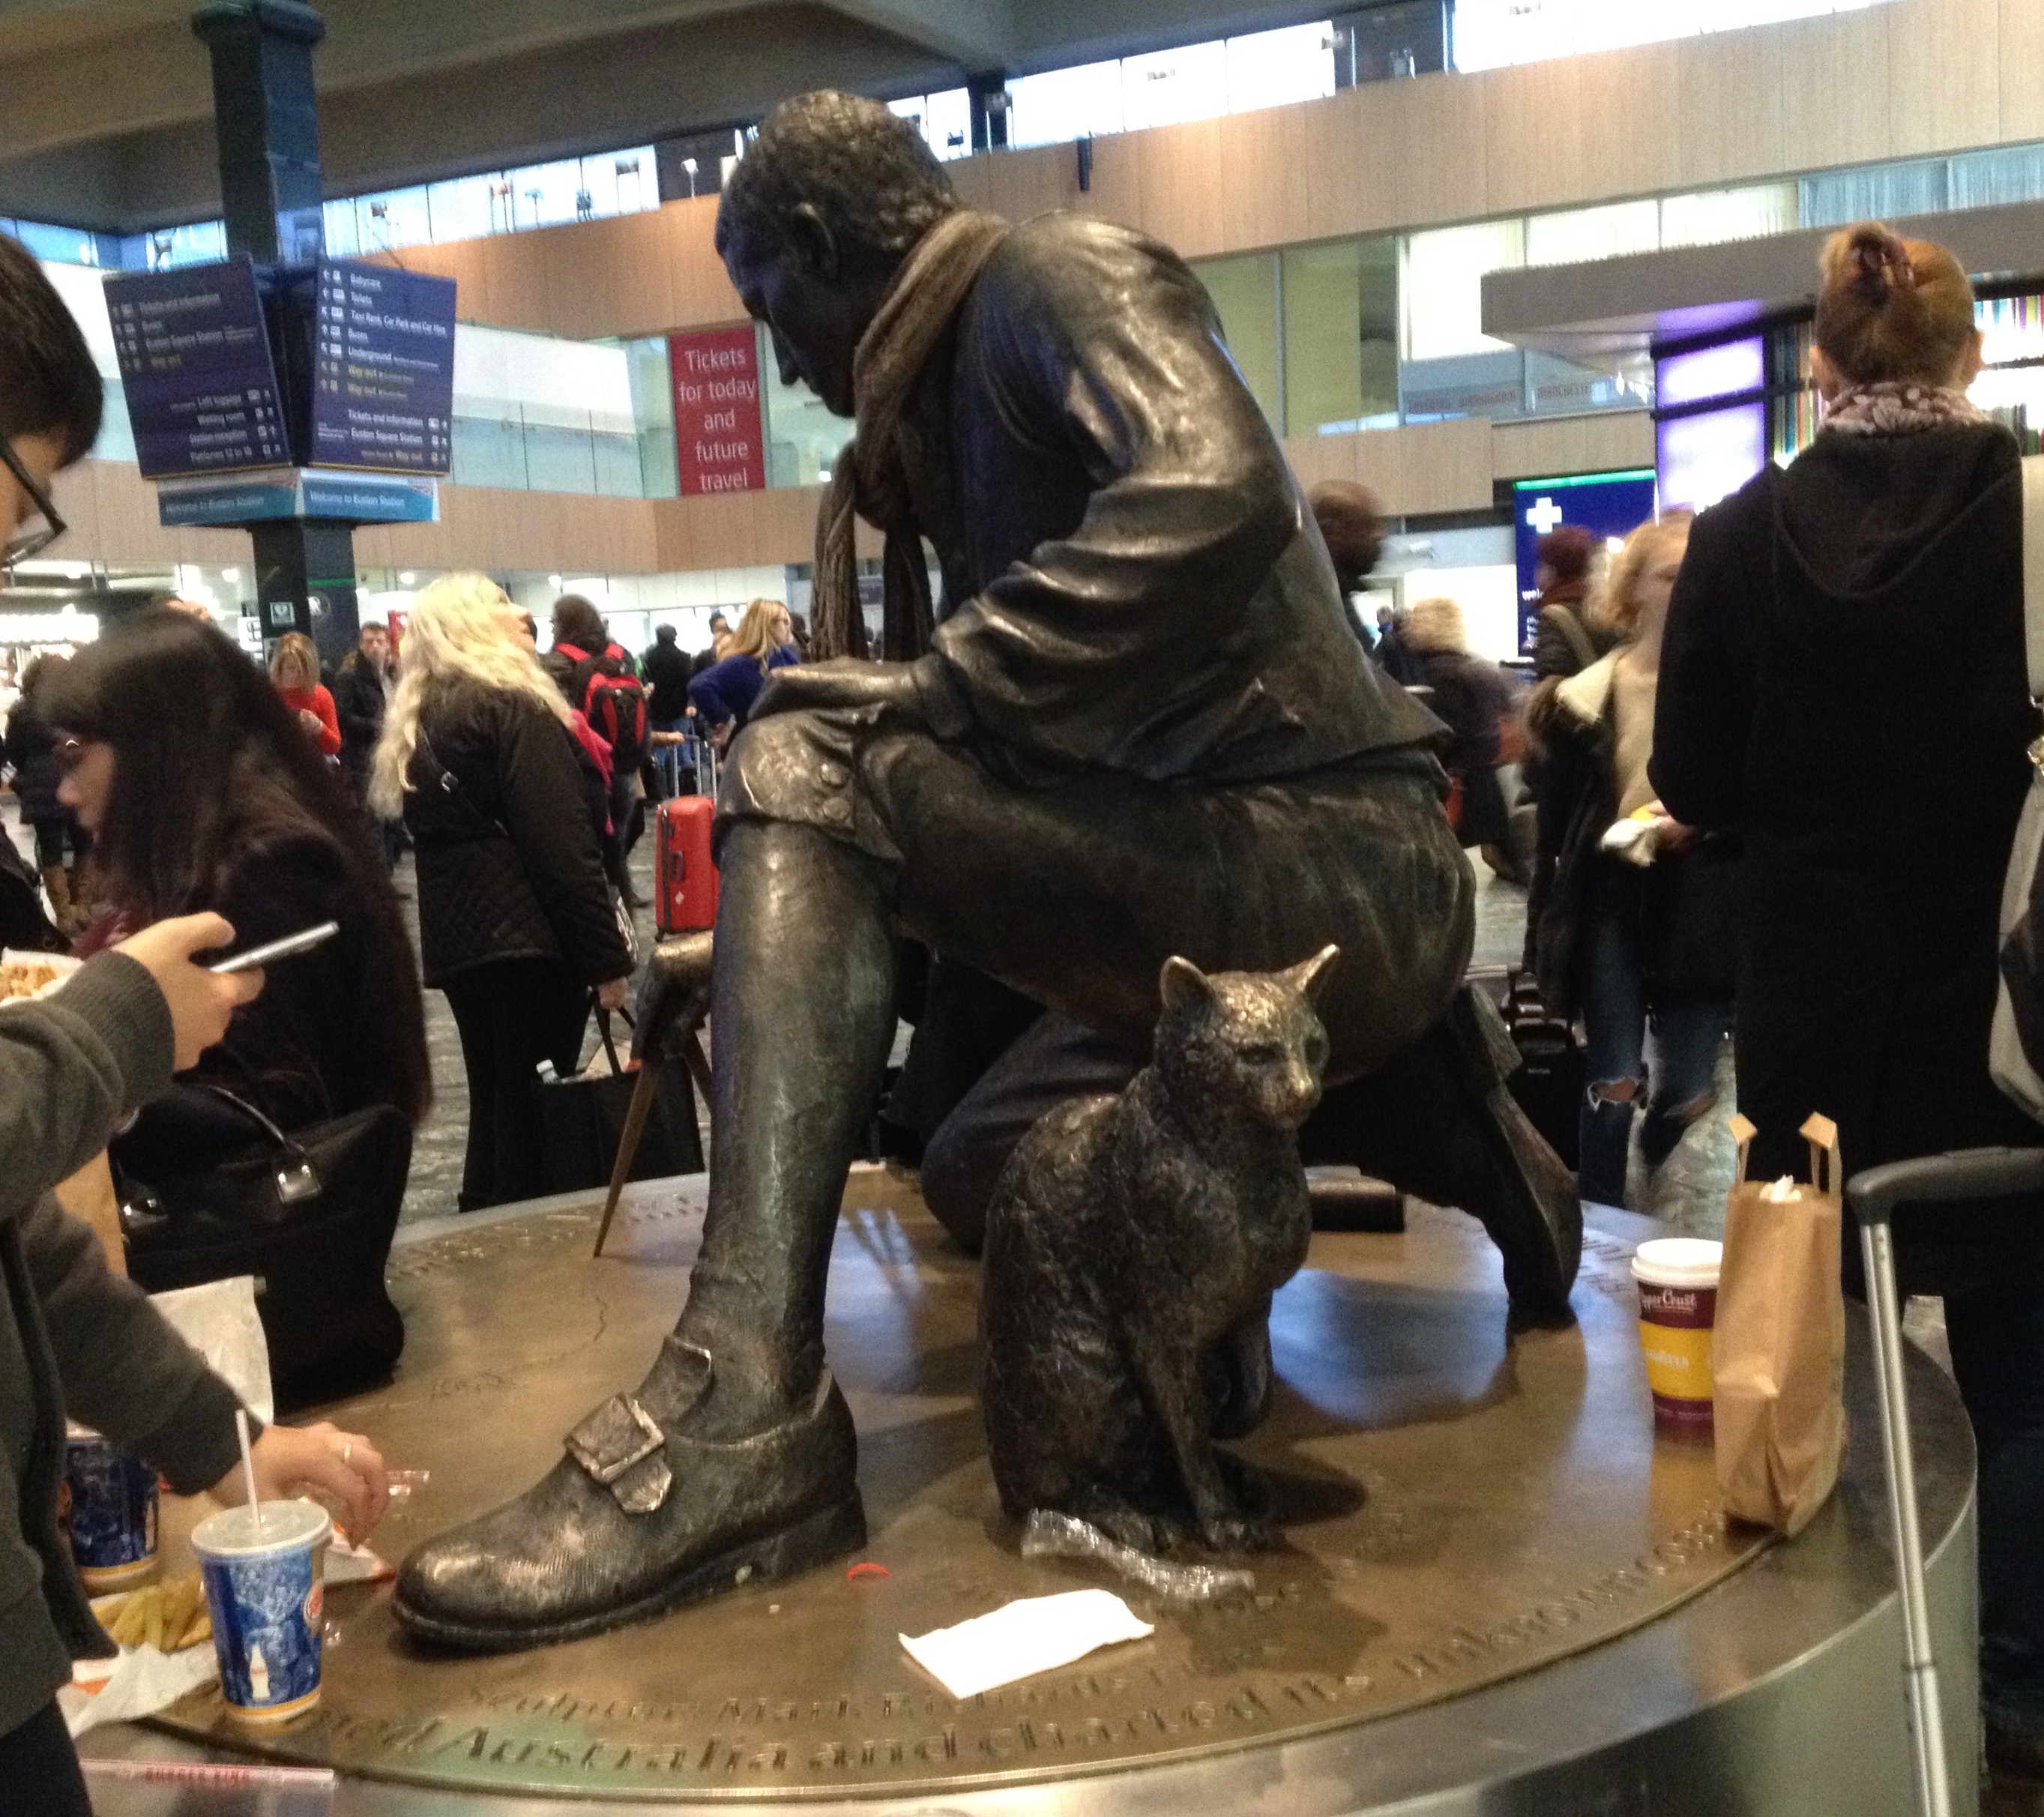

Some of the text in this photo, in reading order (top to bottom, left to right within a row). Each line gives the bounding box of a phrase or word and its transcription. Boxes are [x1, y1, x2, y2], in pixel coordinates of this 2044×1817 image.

[349, 346, 391, 362] Underground
[684, 347, 746, 370] Tickets
[679, 377, 756, 403] for today
[348, 409, 372, 422] Tickets
[705, 408, 735, 433] and
[352, 428, 375, 441] Euston
[376, 430, 398, 442] Square
[400, 433, 423, 444] Station
[696, 442, 748, 462] future
[700, 467, 747, 492] travel
[310, 491, 343, 503] Welcome
[353, 493, 378, 504] Euston
[380, 495, 405, 507] Station
[435, 1724, 789, 1774] Australia
[808, 1723, 961, 1774] and
